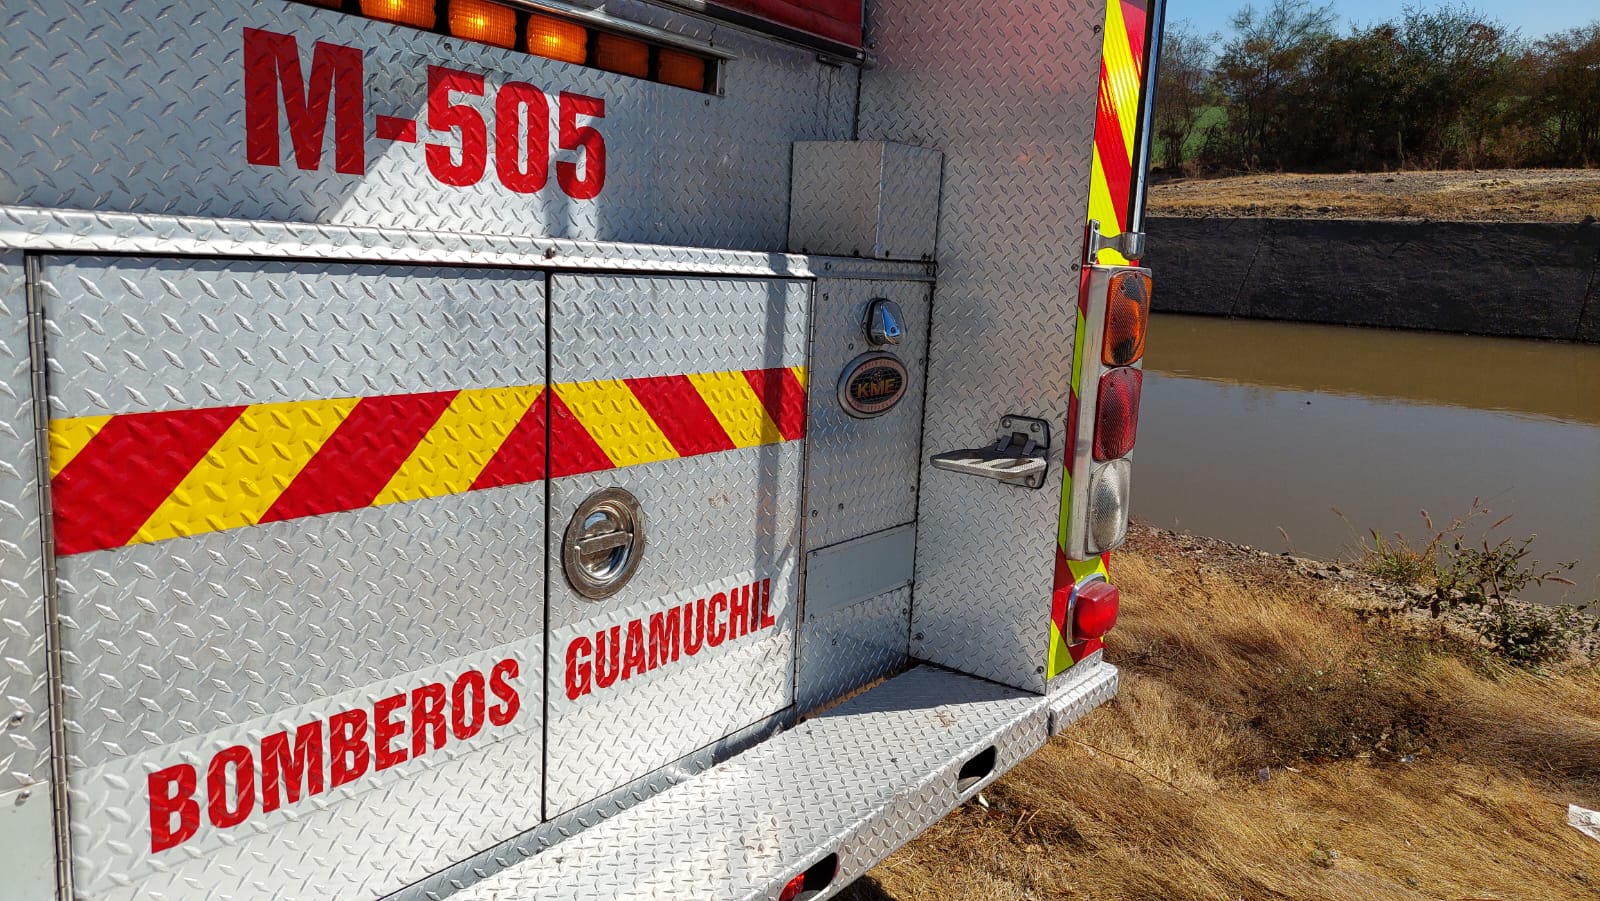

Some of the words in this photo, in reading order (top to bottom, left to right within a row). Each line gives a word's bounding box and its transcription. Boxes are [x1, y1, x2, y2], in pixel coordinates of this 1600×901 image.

[244, 28, 606, 201] M-505
[857, 379, 896, 398] KME
[148, 659, 520, 853] BOMBEROS
[565, 579, 776, 701] GUAMUCHIL
